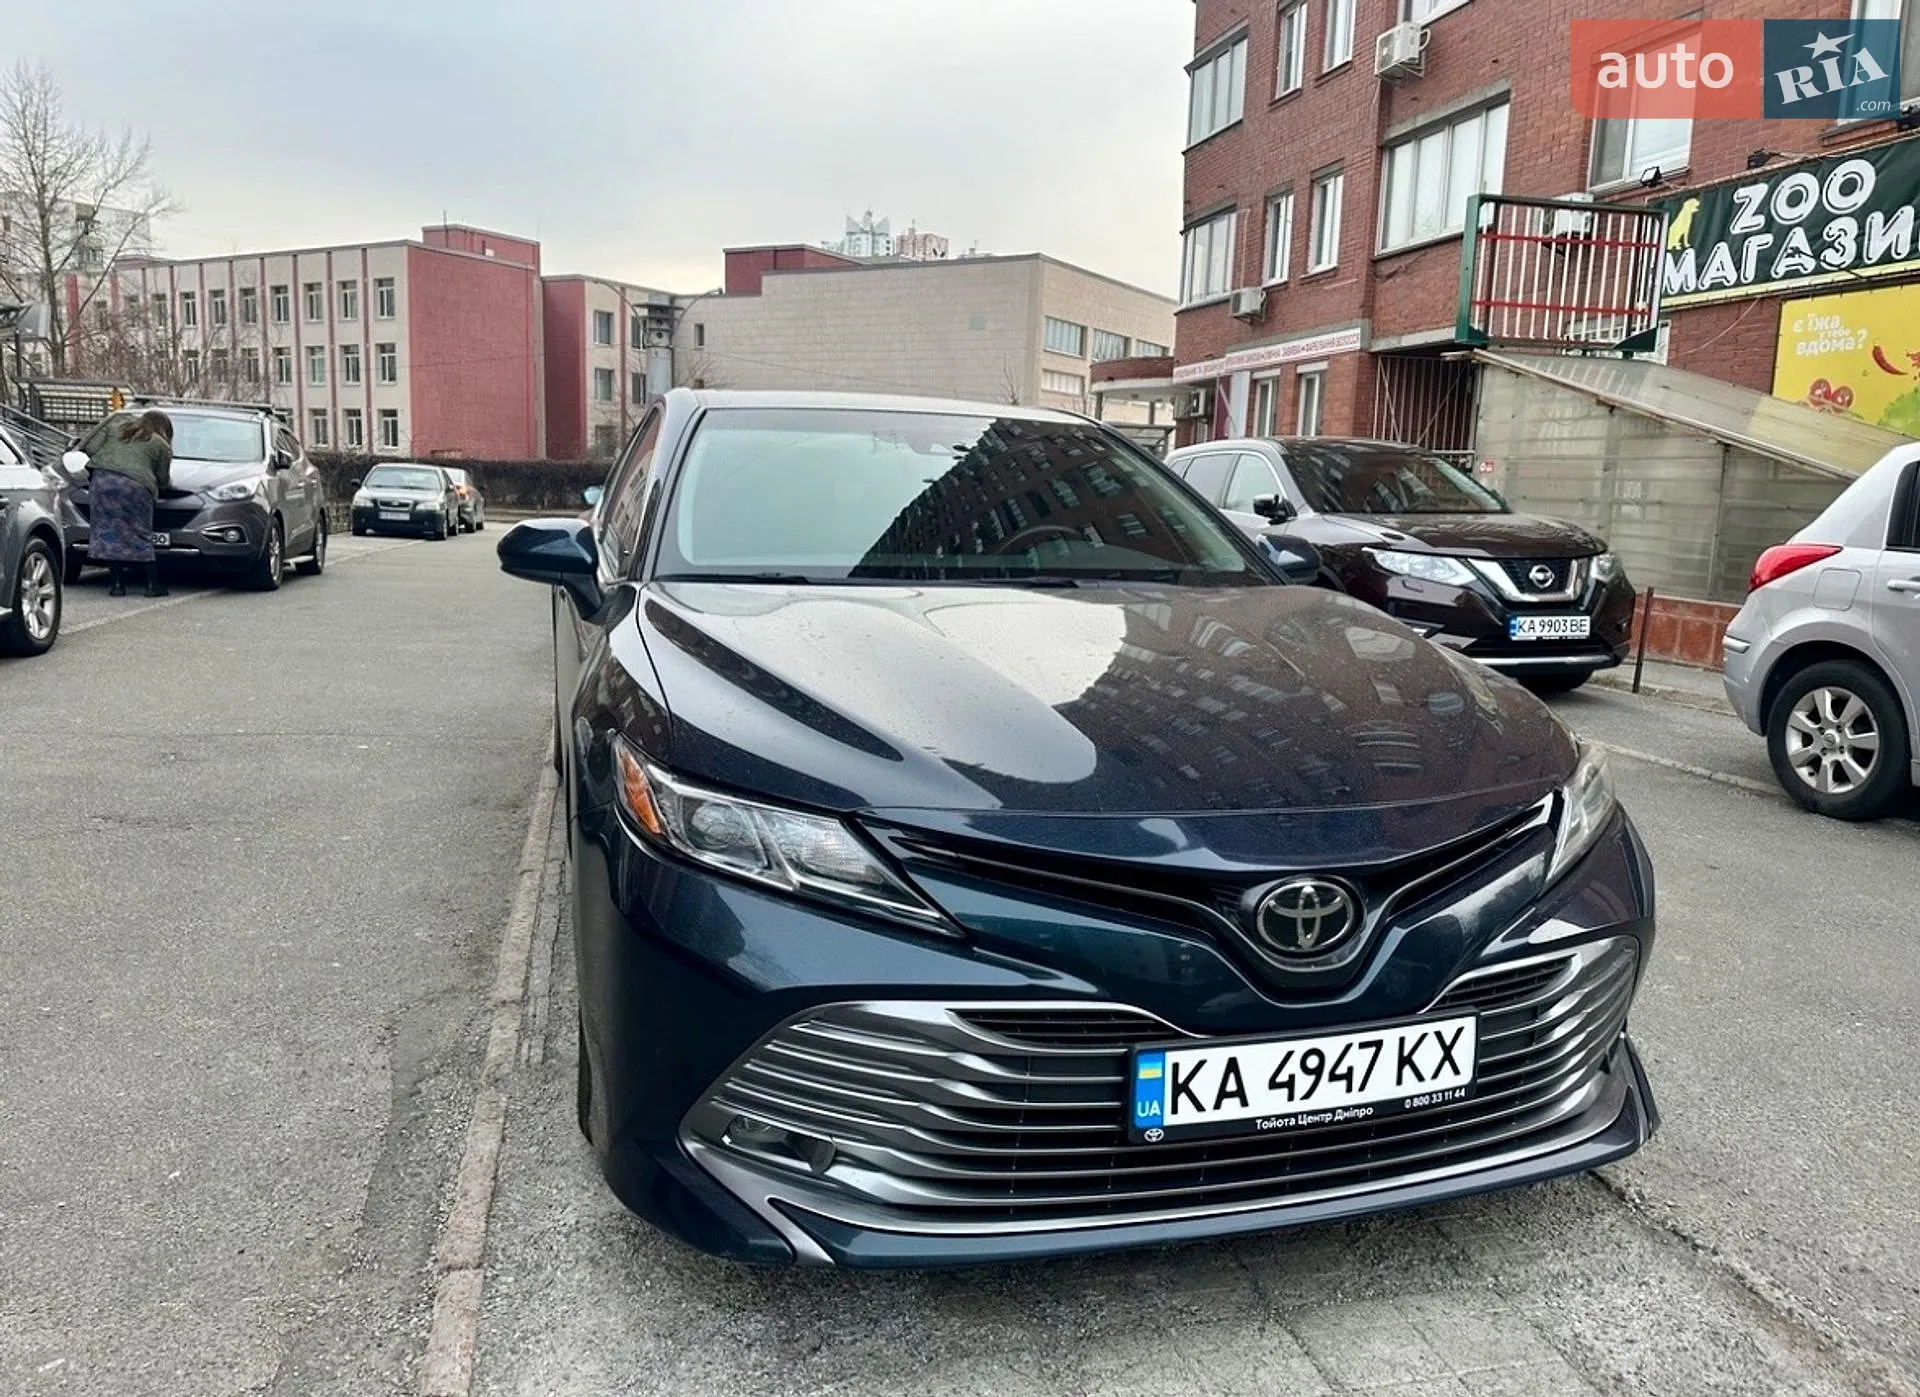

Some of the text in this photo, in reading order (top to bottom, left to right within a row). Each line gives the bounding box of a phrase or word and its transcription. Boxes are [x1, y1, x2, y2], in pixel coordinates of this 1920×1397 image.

[1730, 159, 1877, 235] ZOO
[1663, 205, 1920, 294] МАГАЗИ
[1518, 619, 1588, 633] KA 9903 BE
[1171, 1026, 1465, 1115] KA 4947 KX
[1137, 1100, 1161, 1117] UA
[1256, 1107, 1374, 1130] Тойота Центр Дніпро
